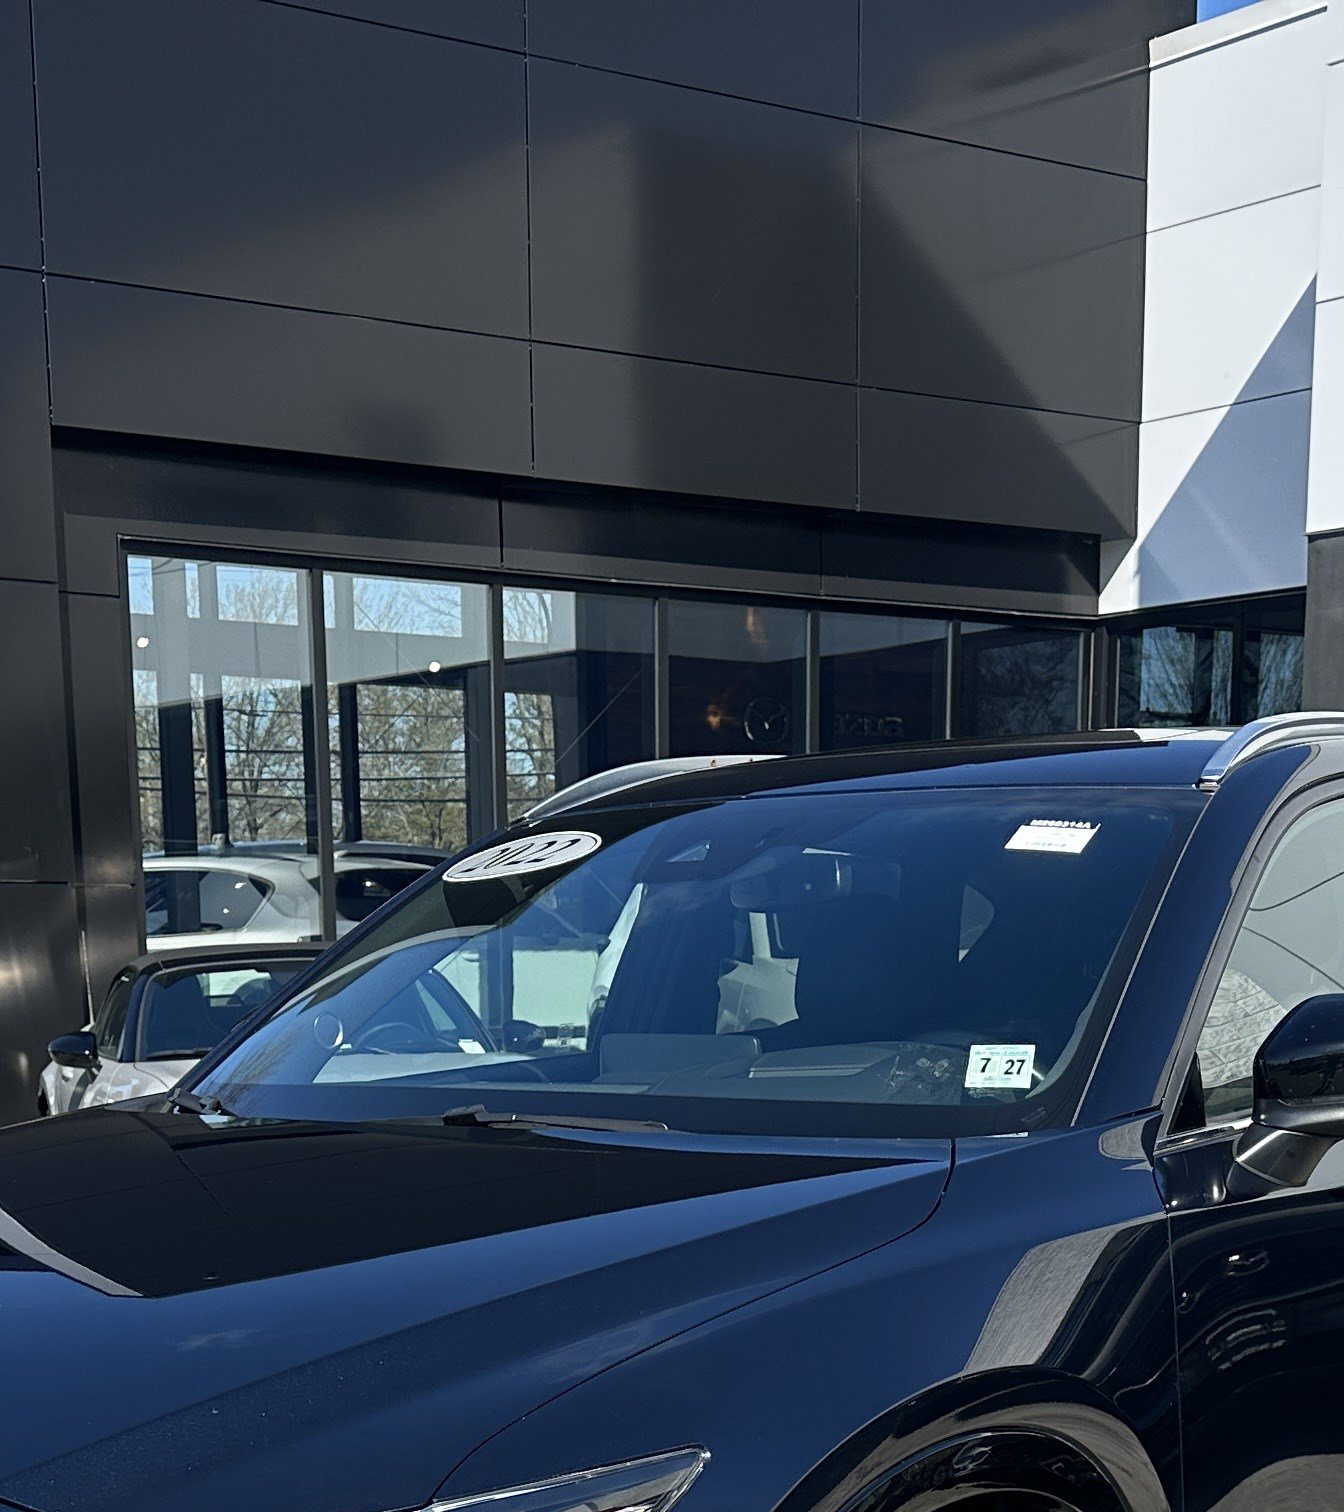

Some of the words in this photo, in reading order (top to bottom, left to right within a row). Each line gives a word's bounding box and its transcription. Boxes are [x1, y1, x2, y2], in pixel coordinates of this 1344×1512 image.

[455, 838, 582, 874] 2022
[980, 1057, 992, 1074] 7
[1003, 1058, 1027, 1075] 27
